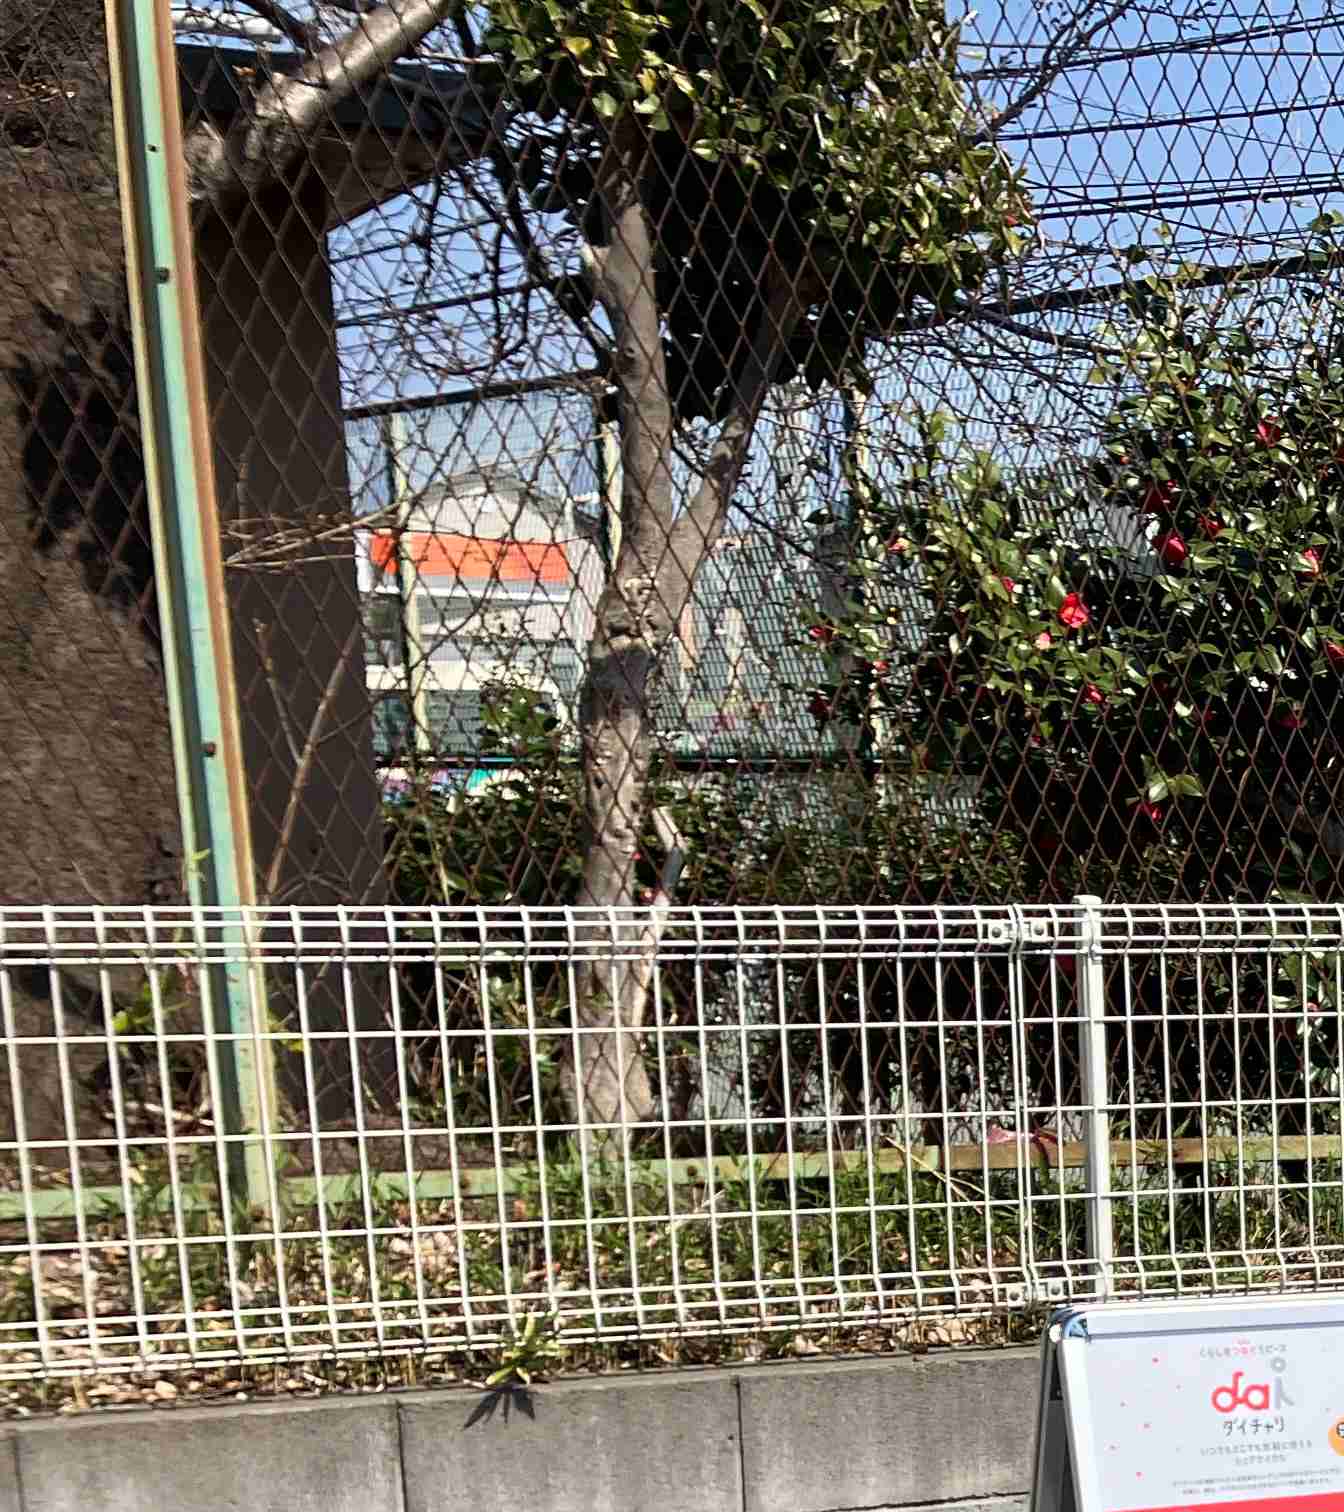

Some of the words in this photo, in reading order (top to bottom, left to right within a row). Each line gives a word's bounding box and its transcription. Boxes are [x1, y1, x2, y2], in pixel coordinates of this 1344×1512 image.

[1211, 1357, 1295, 1413] dai
[1222, 1416, 1287, 1437] ダイチャリ
